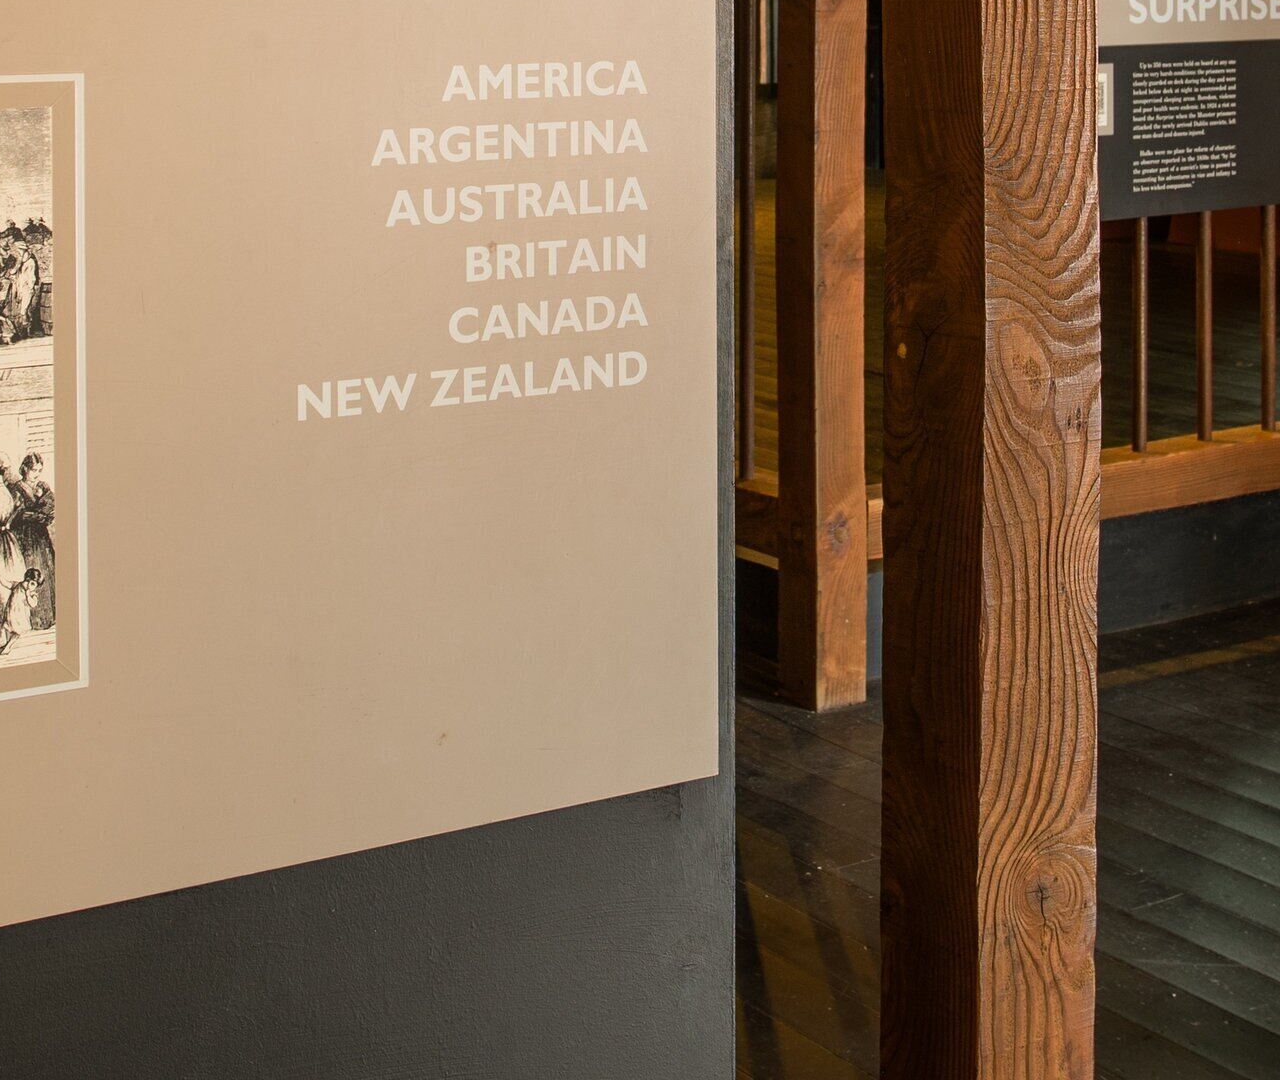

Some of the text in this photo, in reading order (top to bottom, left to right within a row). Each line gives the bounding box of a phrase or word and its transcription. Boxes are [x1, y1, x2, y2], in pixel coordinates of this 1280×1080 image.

[442, 60, 648, 102] AMERICA
[371, 119, 648, 166] ARGENTINA
[385, 177, 648, 227] AUSTRALIA
[466, 234, 646, 282] BRITAIN
[449, 293, 648, 343] CANADA
[297, 351, 647, 421] NEW ZEALAND
